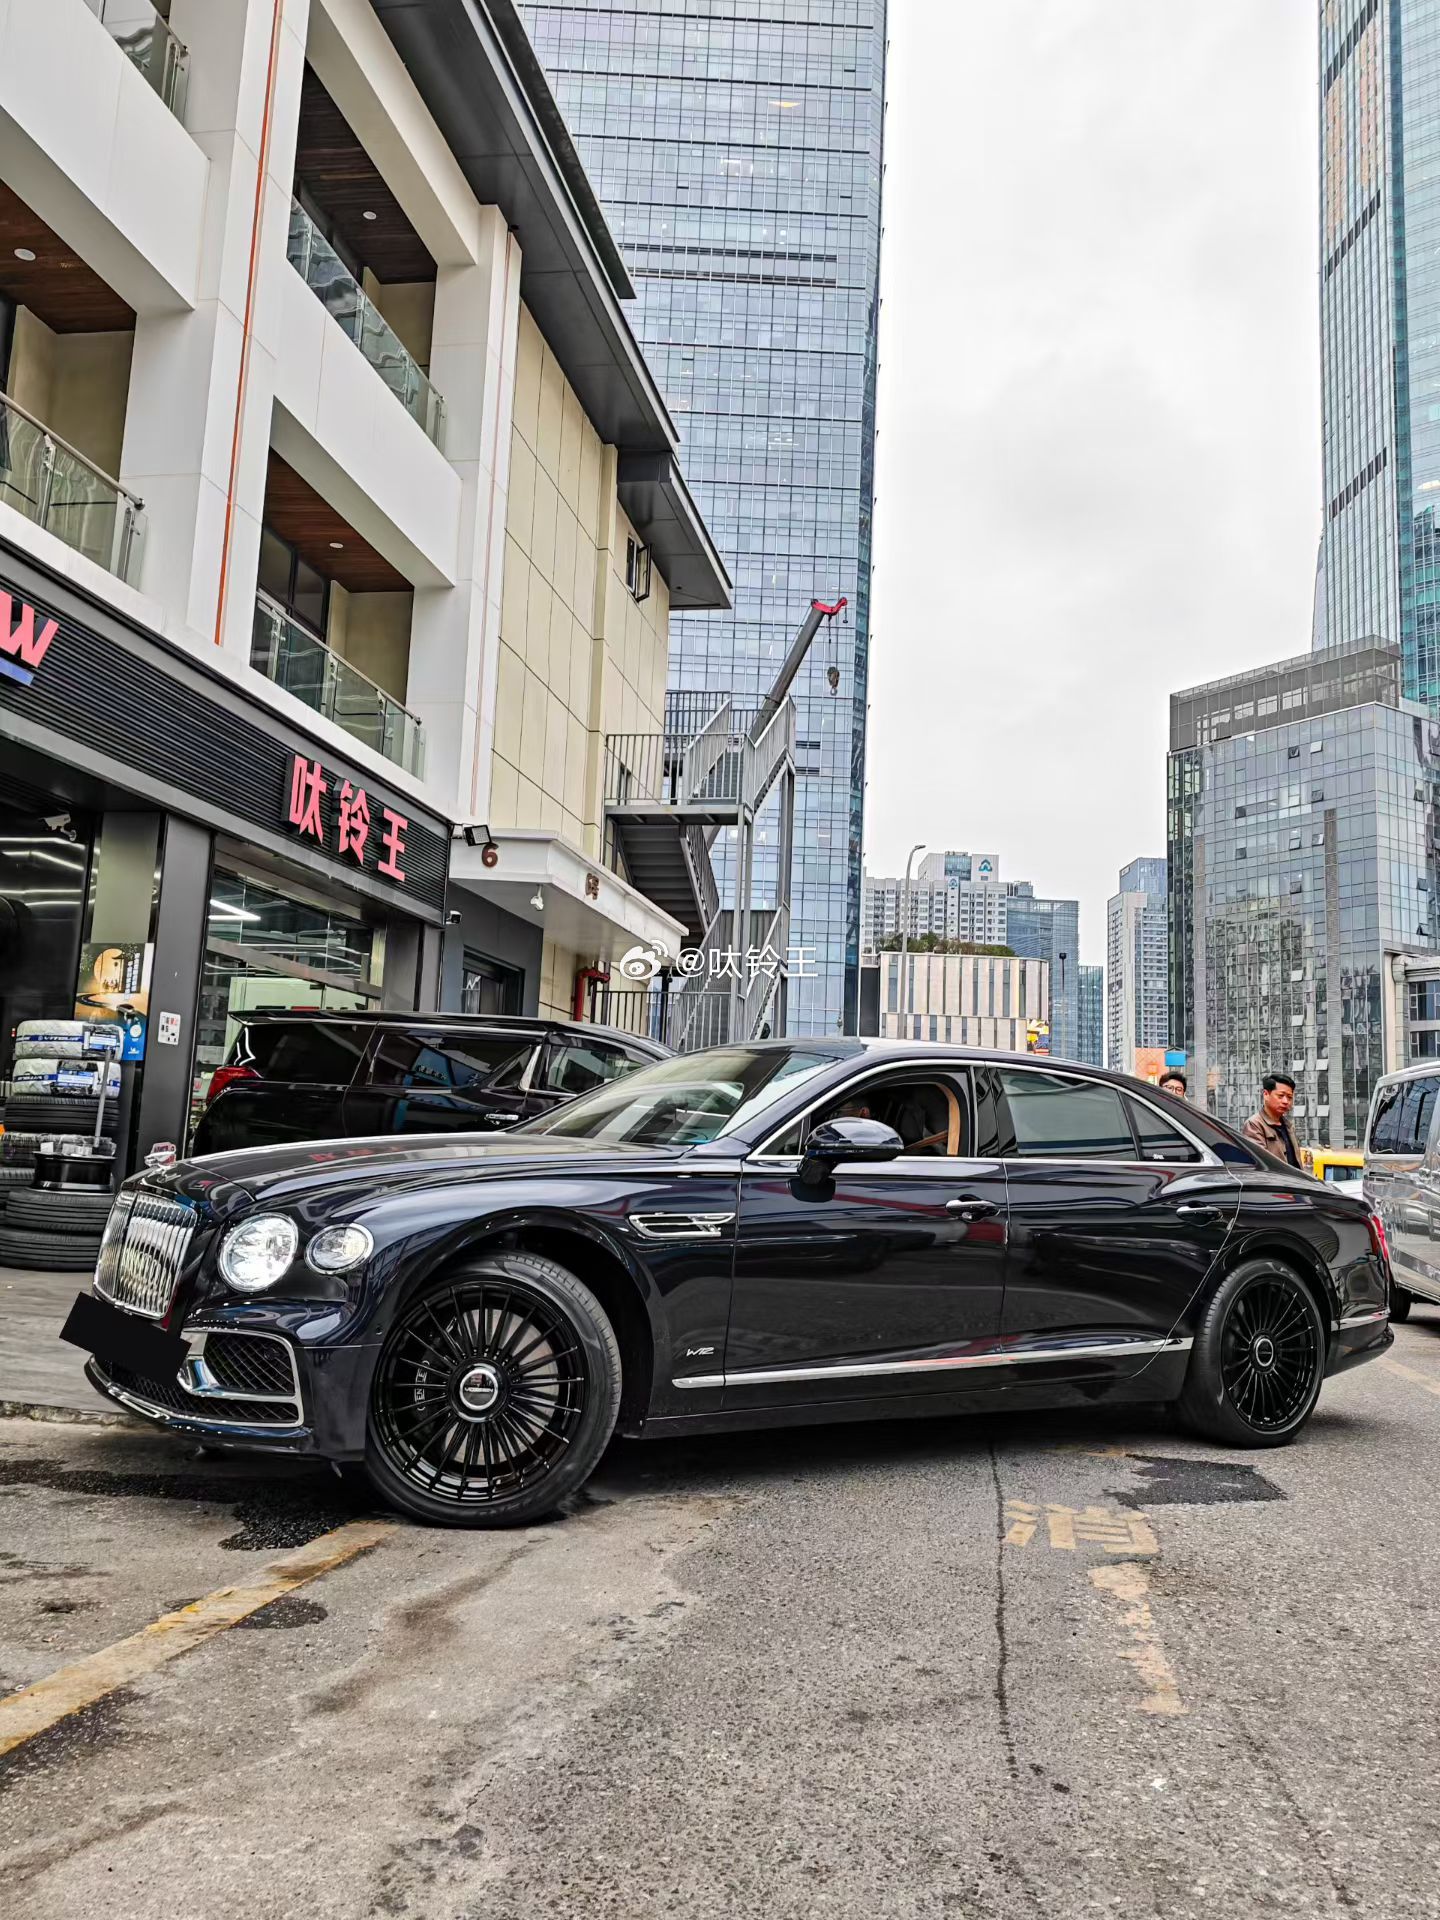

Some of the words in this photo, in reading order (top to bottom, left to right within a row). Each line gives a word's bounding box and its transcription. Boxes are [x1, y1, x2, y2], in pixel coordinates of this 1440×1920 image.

[289, 754, 409, 882] 呔铃王
[481, 842, 499, 868] 6
[1003, 1498, 1161, 1554] 消
